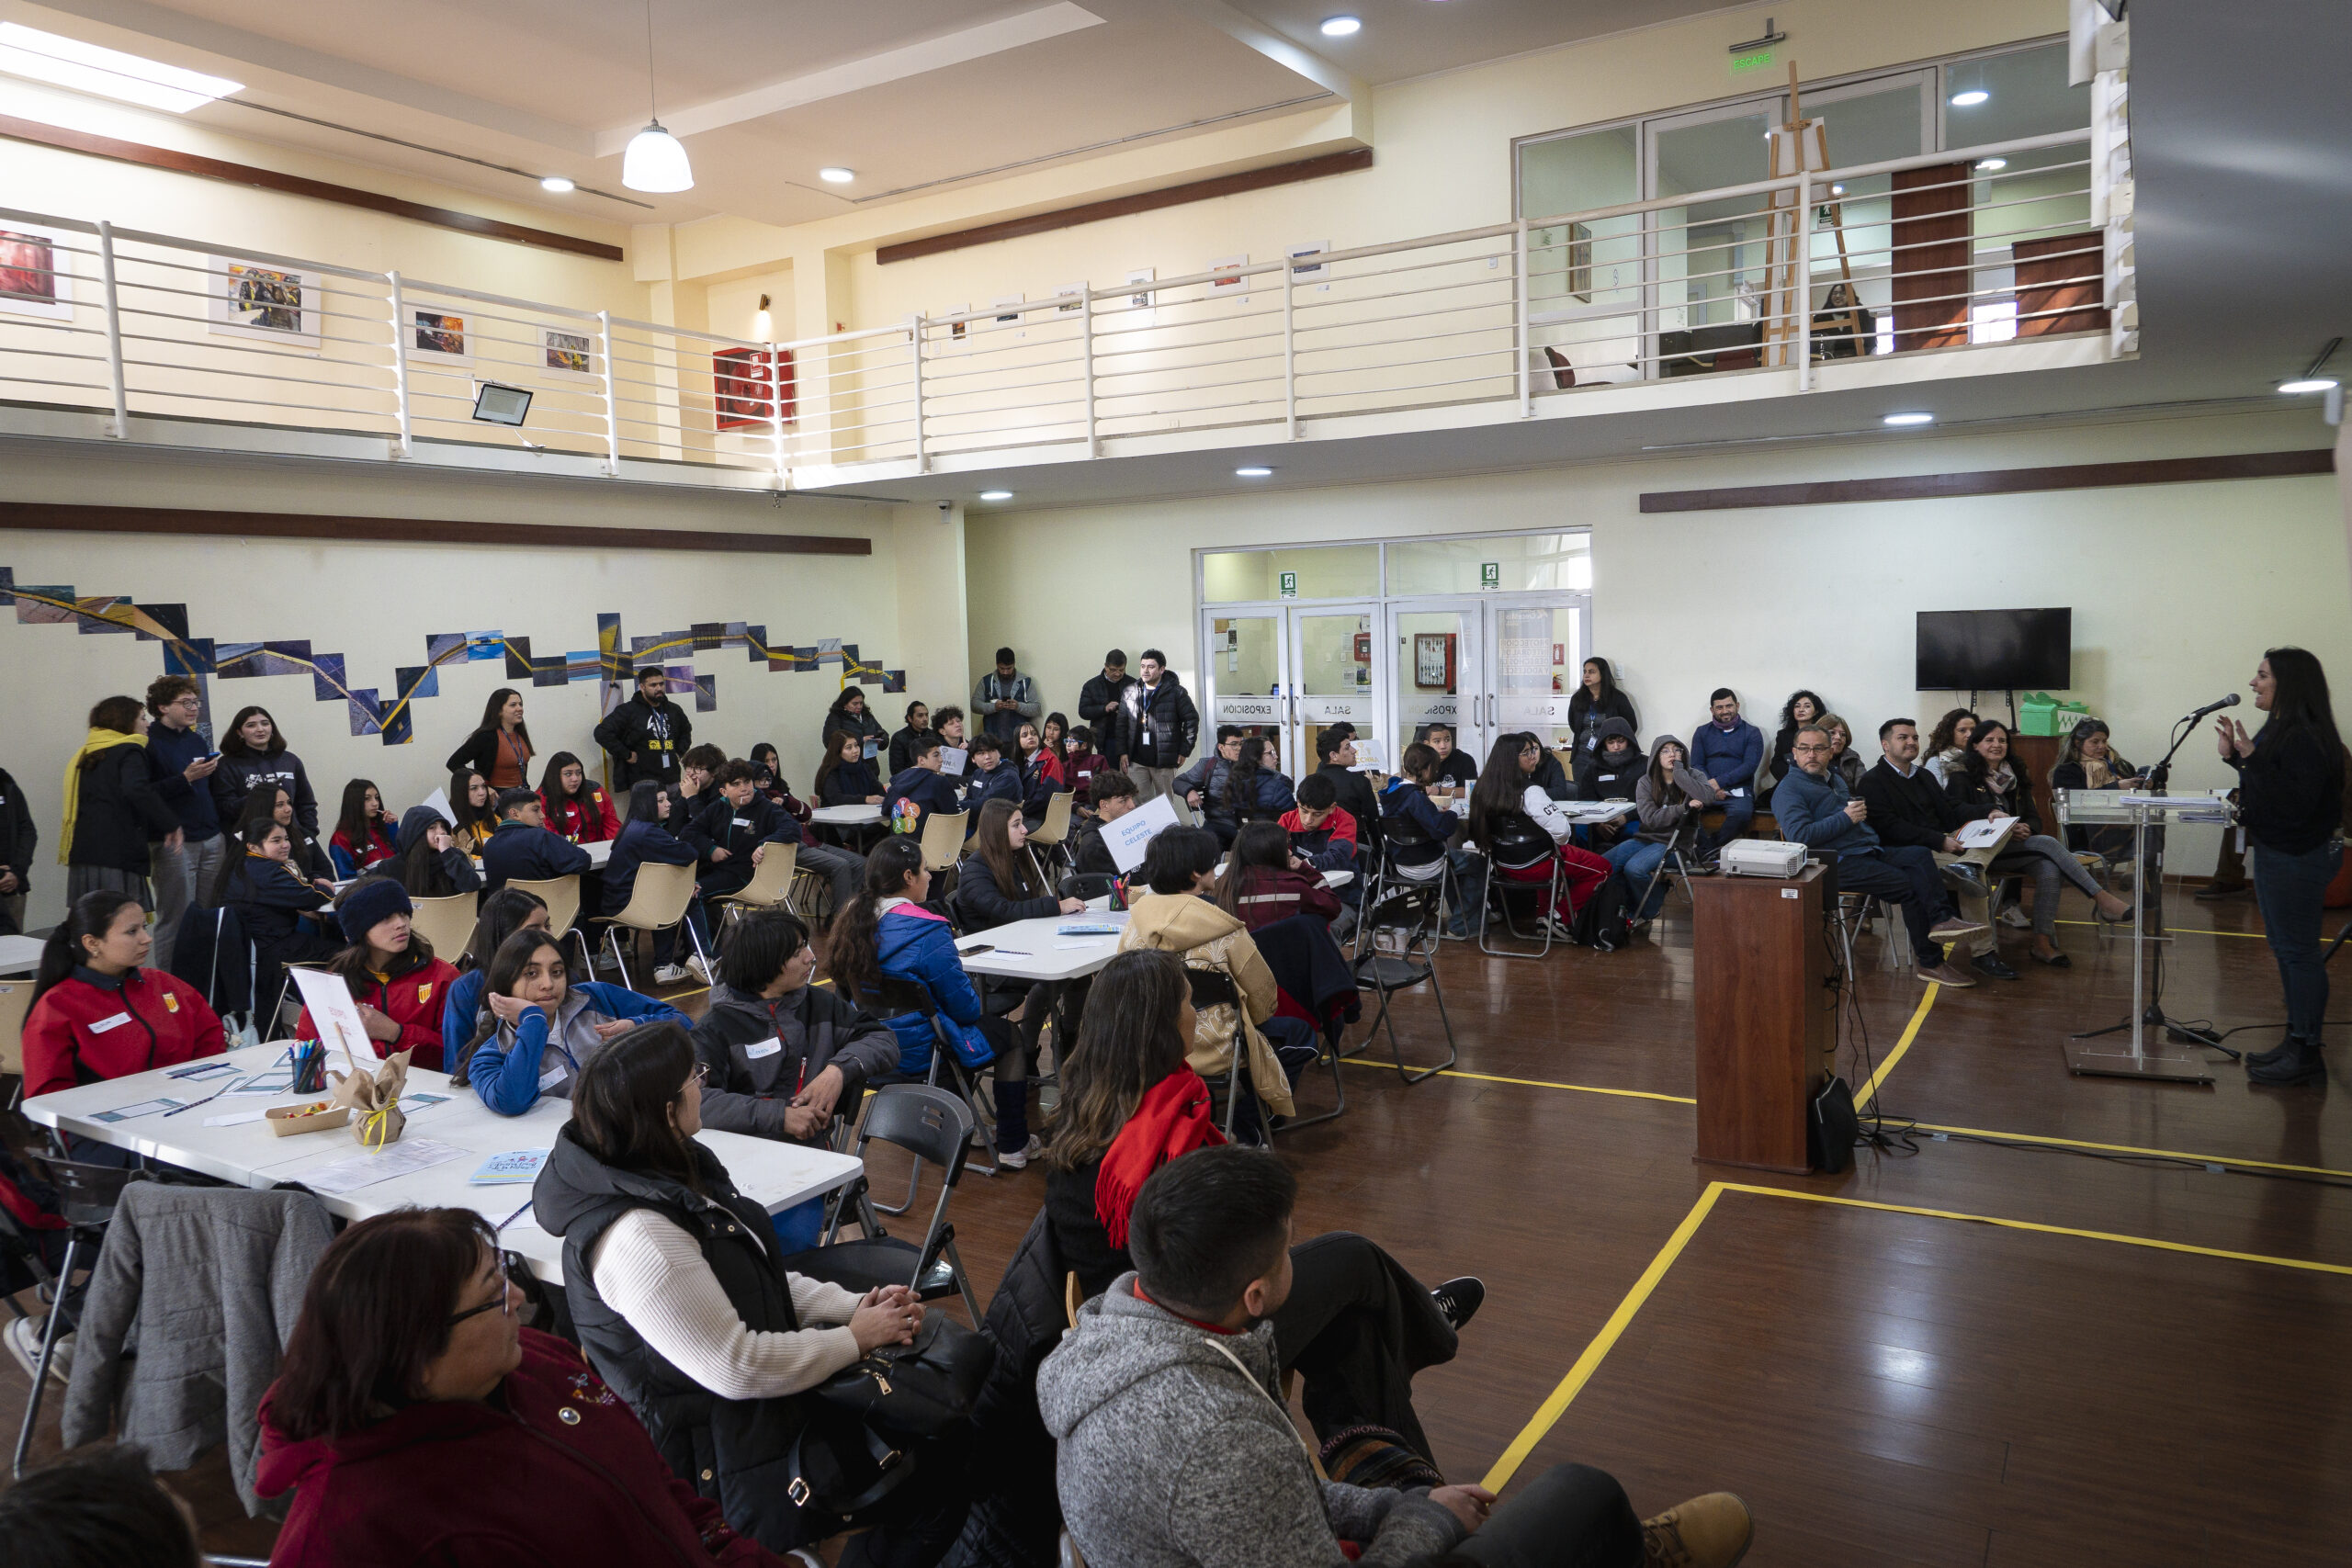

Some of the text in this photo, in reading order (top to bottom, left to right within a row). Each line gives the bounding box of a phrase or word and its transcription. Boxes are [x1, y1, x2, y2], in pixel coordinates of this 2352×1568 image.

[1734, 52, 1770, 70] ESCAPE
[1121, 820, 1146, 836] EQUIPO
[1125, 829, 1152, 845] CELESTE
